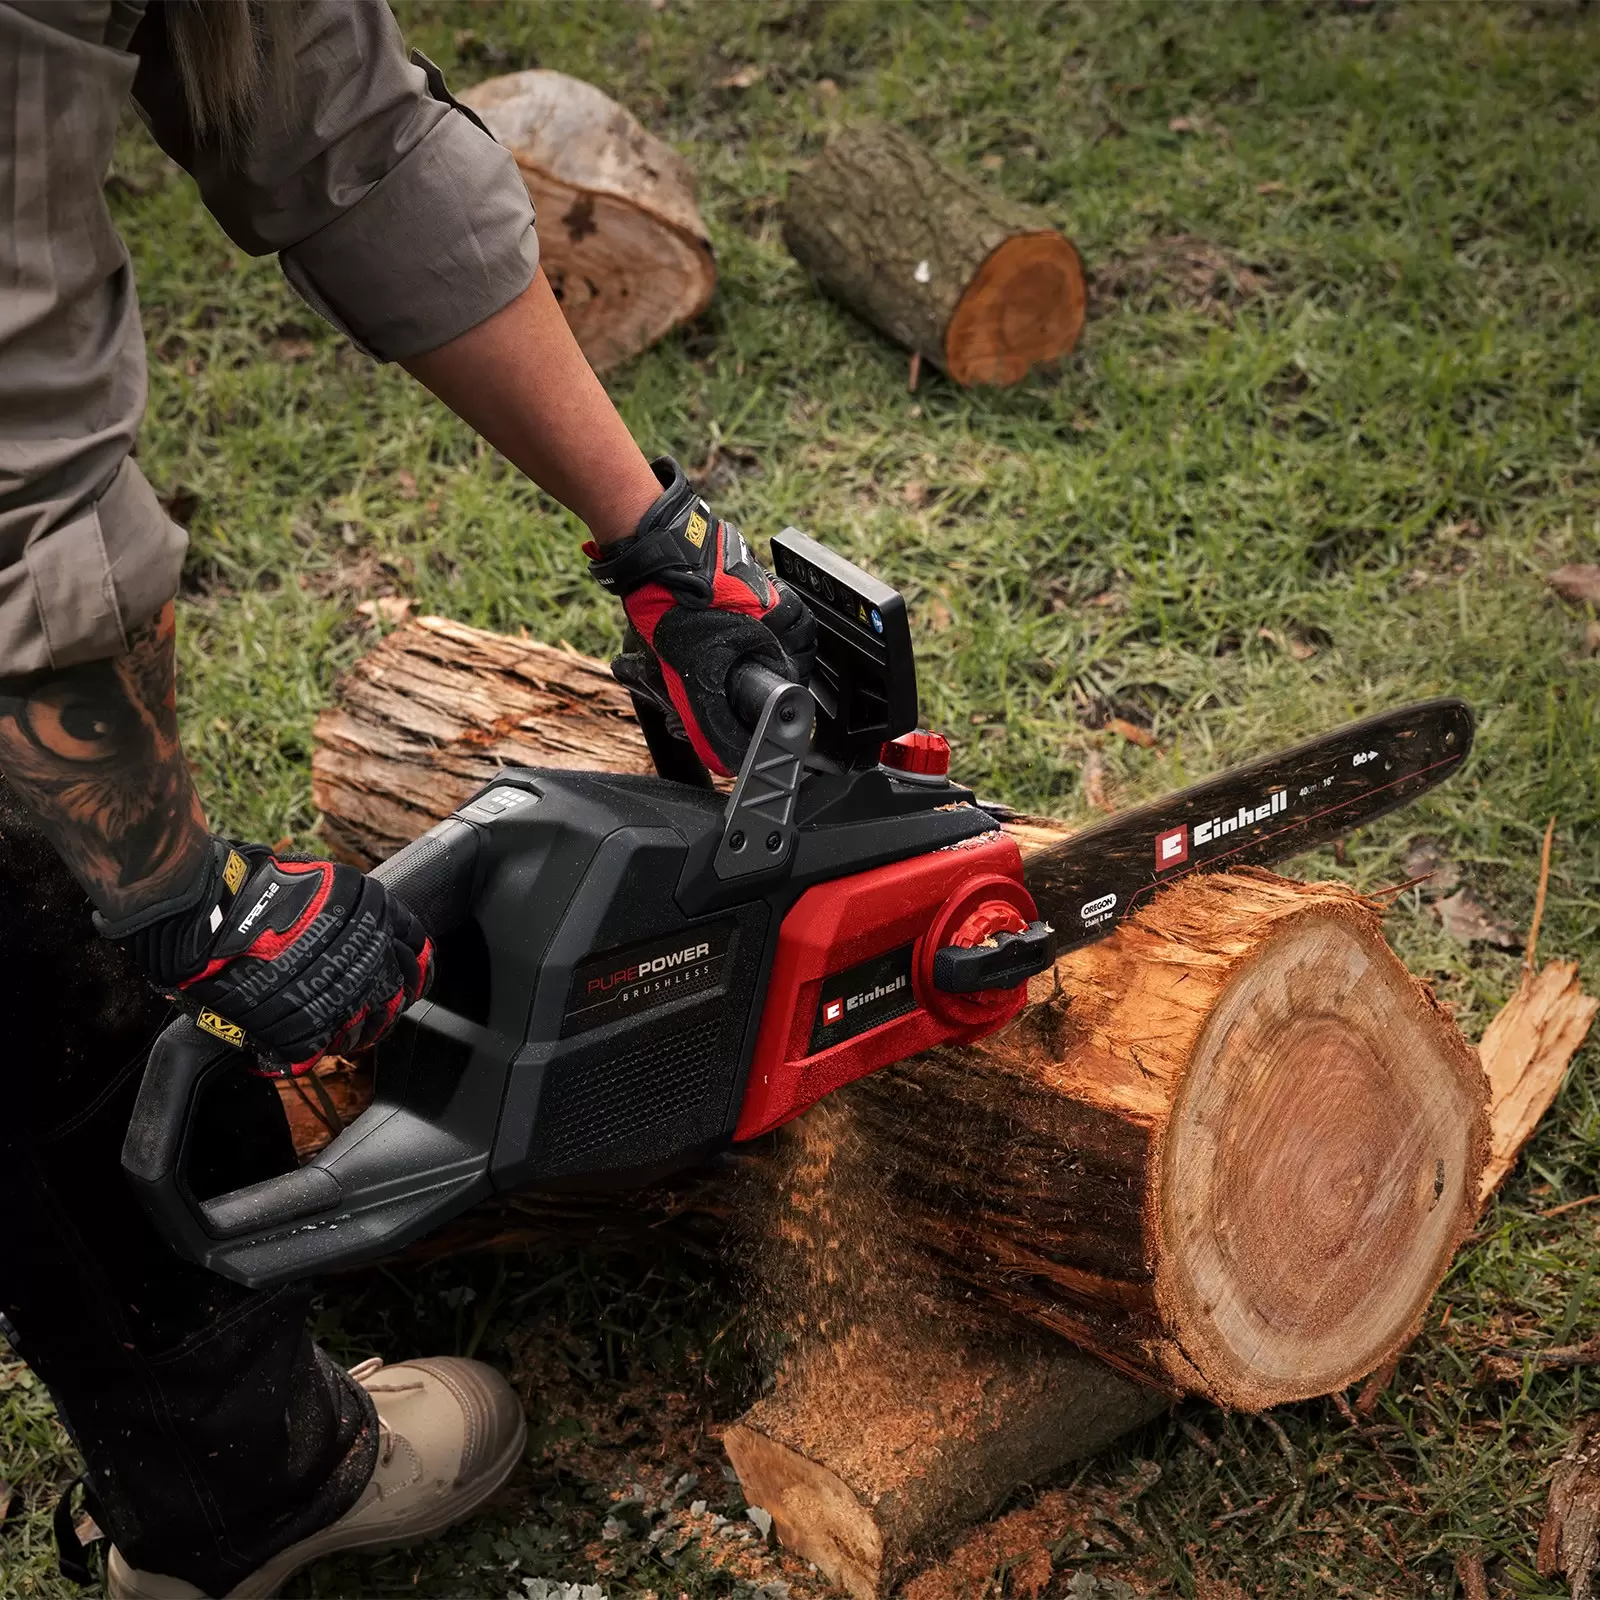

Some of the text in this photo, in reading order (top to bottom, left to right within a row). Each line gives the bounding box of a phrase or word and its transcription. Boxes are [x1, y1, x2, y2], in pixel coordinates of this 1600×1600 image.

[1193, 789, 1287, 847] Einhell
[1083, 897, 1114, 916] OREGON
[622, 965, 709, 1002] BRUSHLESS
[846, 974, 906, 1012] Einhell
